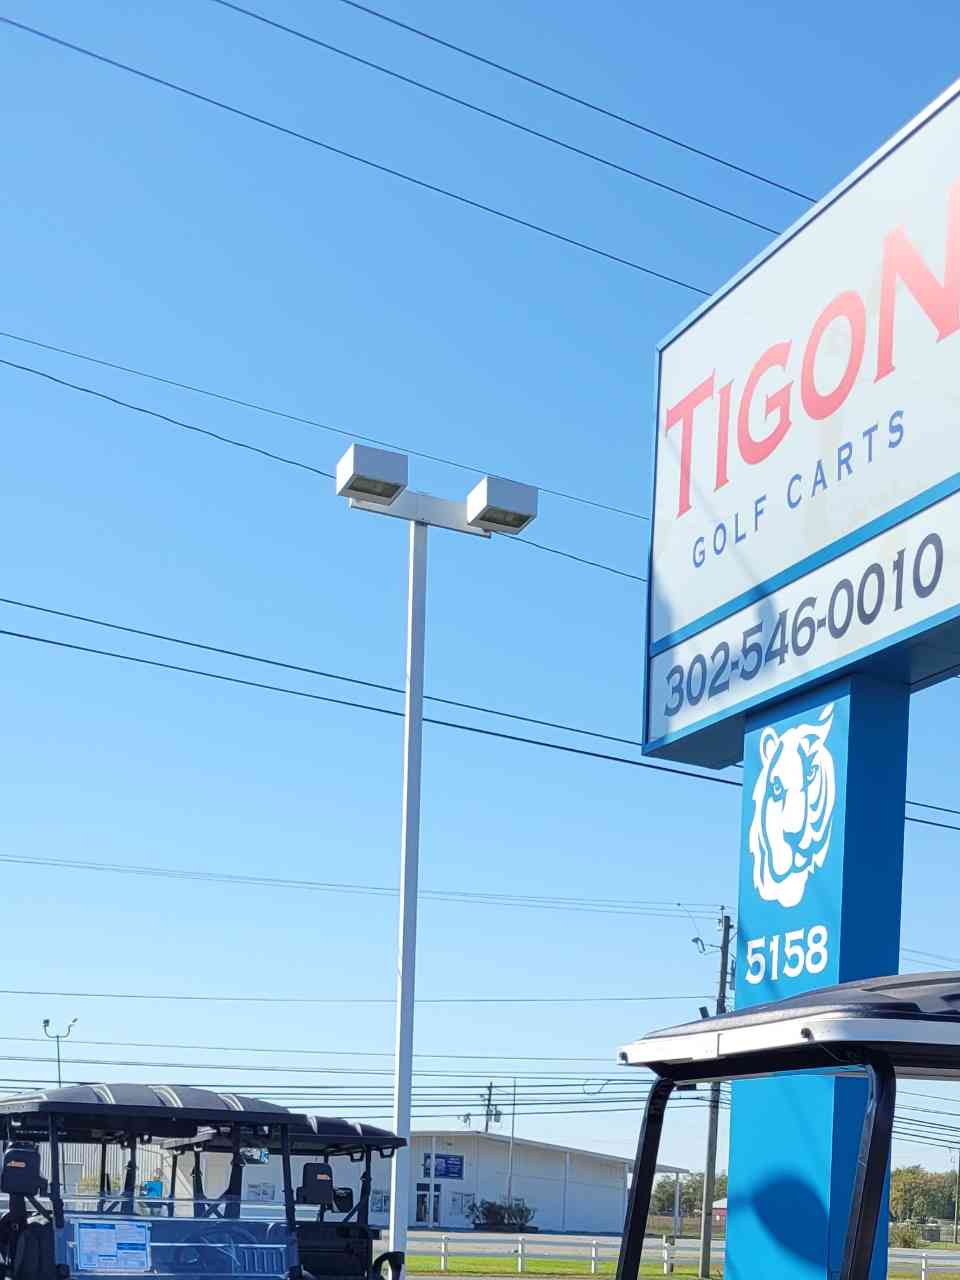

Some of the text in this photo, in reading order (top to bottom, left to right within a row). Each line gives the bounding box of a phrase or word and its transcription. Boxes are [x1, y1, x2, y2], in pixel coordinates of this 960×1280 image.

[692, 409, 905, 569] GOLF CARTS
[663, 532, 944, 718] 302-546-0010
[744, 924, 829, 985] 5158
